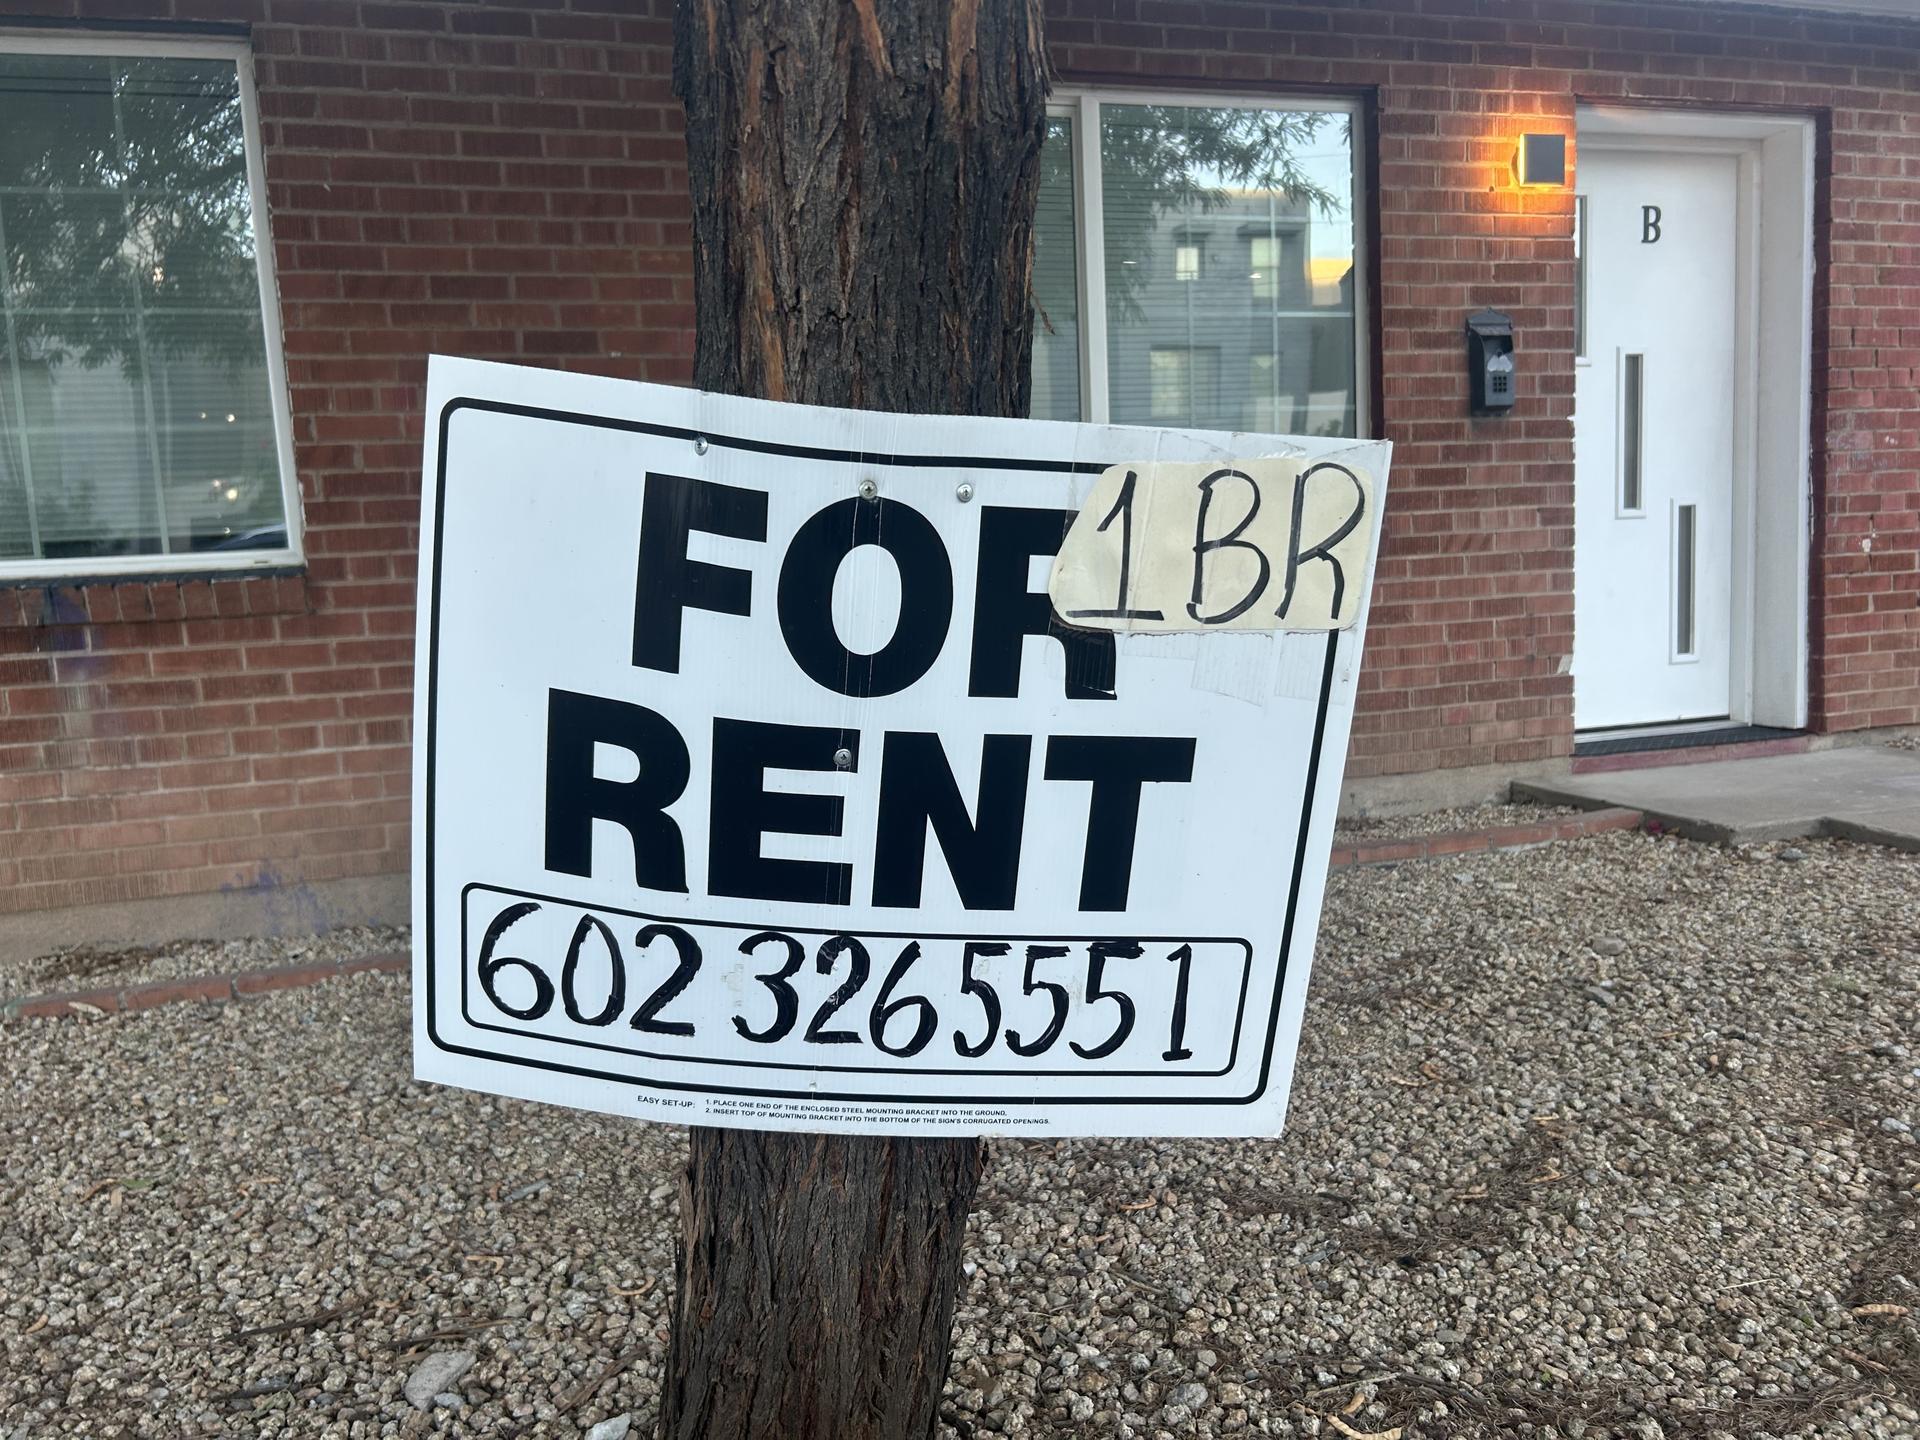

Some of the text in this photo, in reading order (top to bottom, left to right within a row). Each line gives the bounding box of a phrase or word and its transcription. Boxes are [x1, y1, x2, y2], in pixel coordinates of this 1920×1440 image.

[1641, 205, 1662, 243] B
[632, 471, 1117, 701] FOR
[1066, 462, 1365, 625] 1 BR
[545, 687, 1195, 913] RENT
[478, 902, 703, 1036] 602
[637, 1095, 660, 1105] EASY
[713, 1099, 737, 1107] PLACE
[800, 1105, 839, 1113] ENCLOSED
[841, 1106, 864, 1114] STEEL
[768, 1111, 807, 1120] MOUNTING
[808, 1114, 843, 1122] BRACKET
